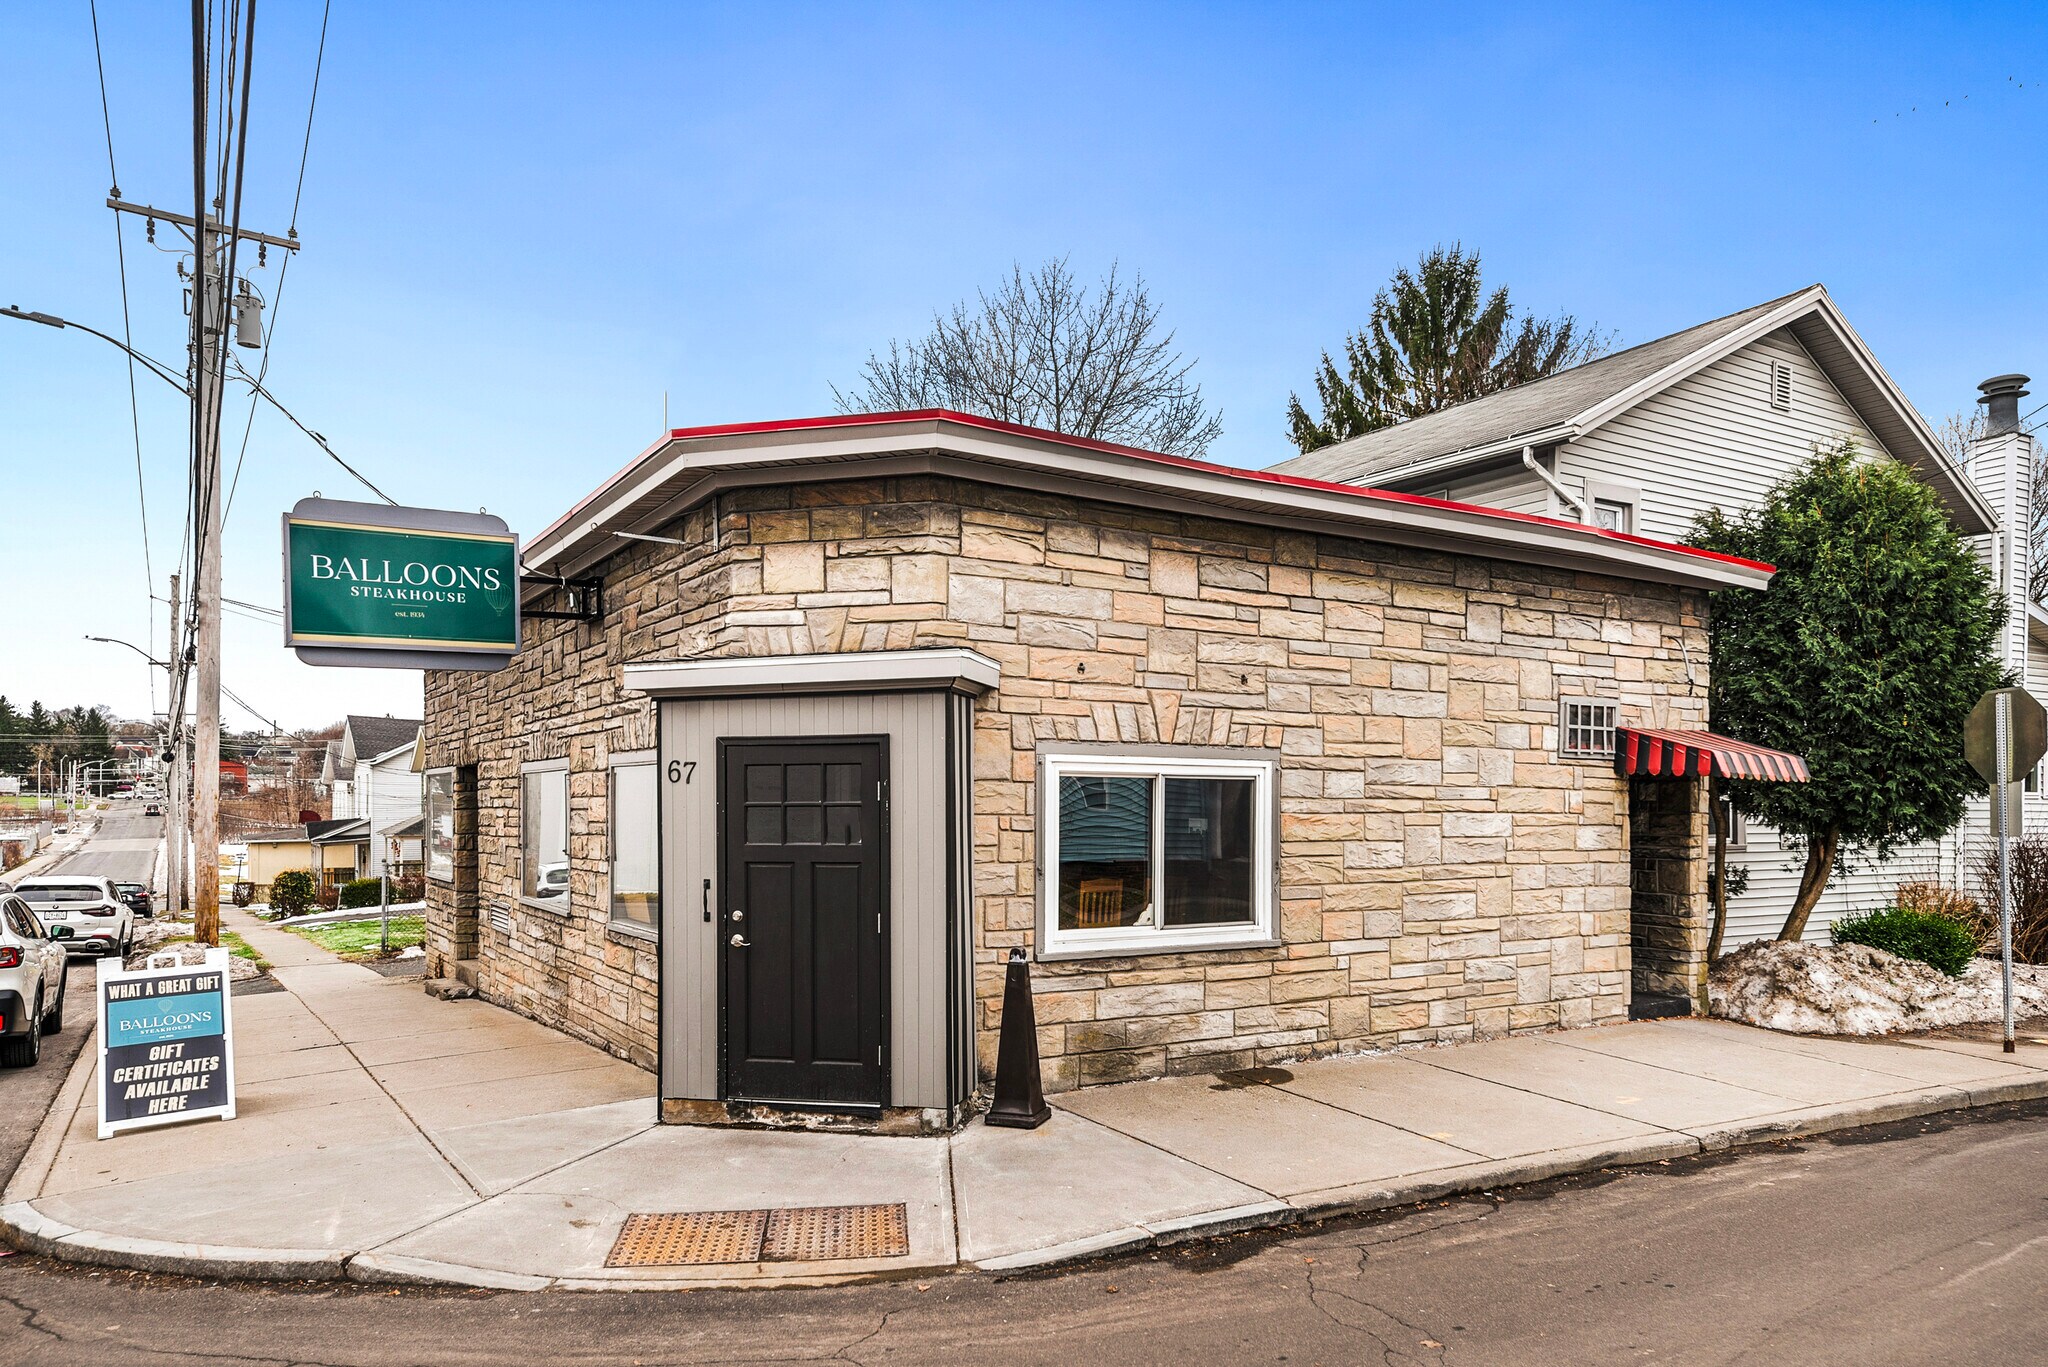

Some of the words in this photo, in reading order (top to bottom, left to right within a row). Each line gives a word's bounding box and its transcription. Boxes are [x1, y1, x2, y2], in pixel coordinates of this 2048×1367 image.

[310, 554, 500, 591] BALLOONS
[350, 585, 466, 603] STEAKHOUSE
[668, 760, 697, 784] 67
[108, 983, 142, 1000] WHAT
[145, 982, 154, 996] A
[158, 976, 193, 995] GREAT
[196, 975, 220, 990] GIFT
[119, 1011, 212, 1031] BALLOONS
[140, 1024, 193, 1034] STEAKHOUSE
[148, 1043, 185, 1061] GIFT
[113, 1056, 220, 1083] CERTIFICATES
[124, 1074, 210, 1100] AVAILABLE
[147, 1095, 188, 1115] HERE
